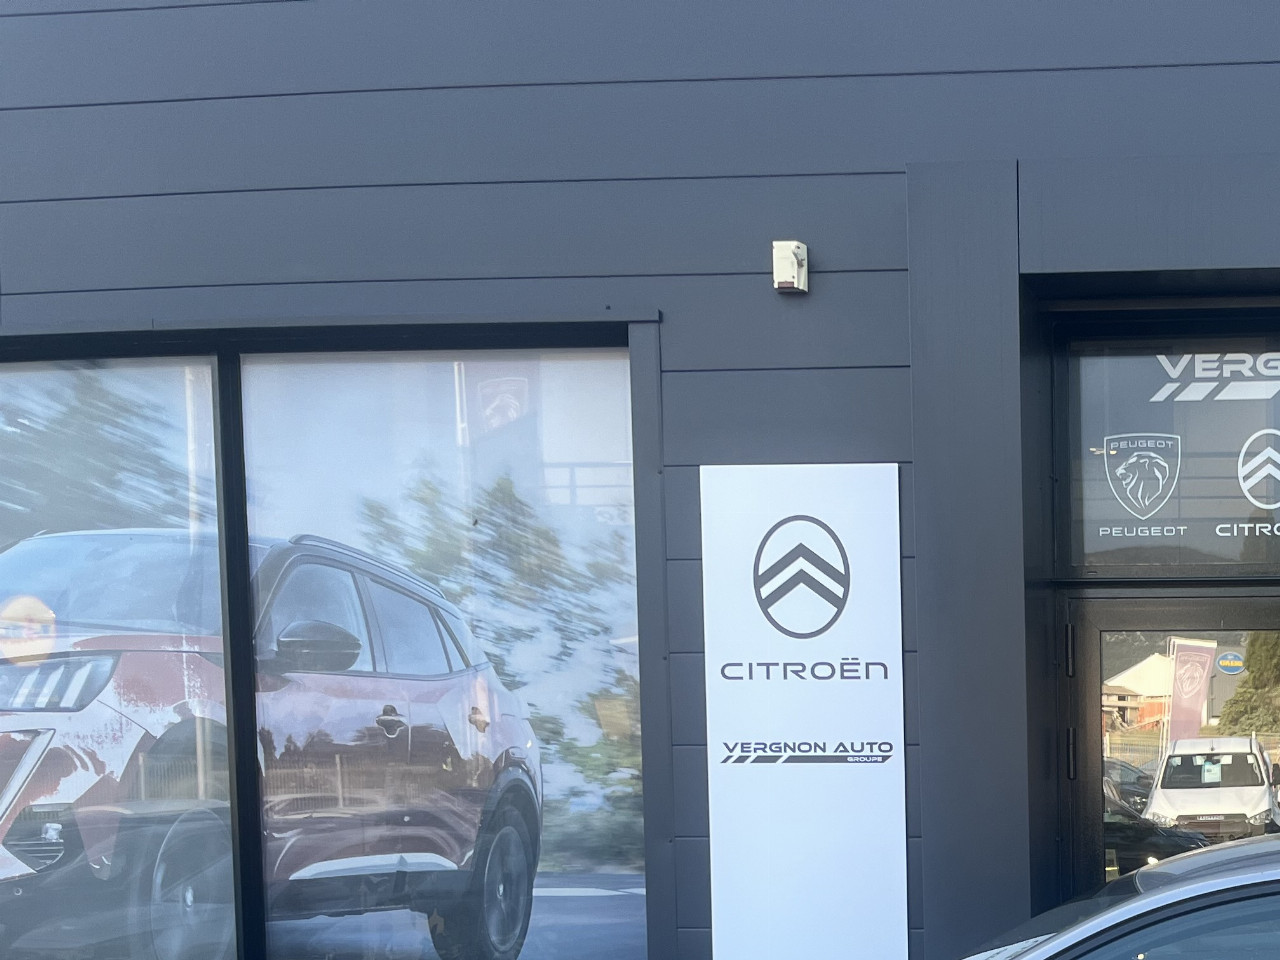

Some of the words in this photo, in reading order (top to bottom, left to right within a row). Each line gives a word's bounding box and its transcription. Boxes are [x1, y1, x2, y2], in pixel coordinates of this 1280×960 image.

[1110, 438, 1174, 450] PEUGEOT
[1099, 526, 1188, 537] PEUGEOT
[720, 657, 889, 681] CITROËN
[722, 742, 827, 754] VERGNON
[833, 741, 894, 754] AUTO
